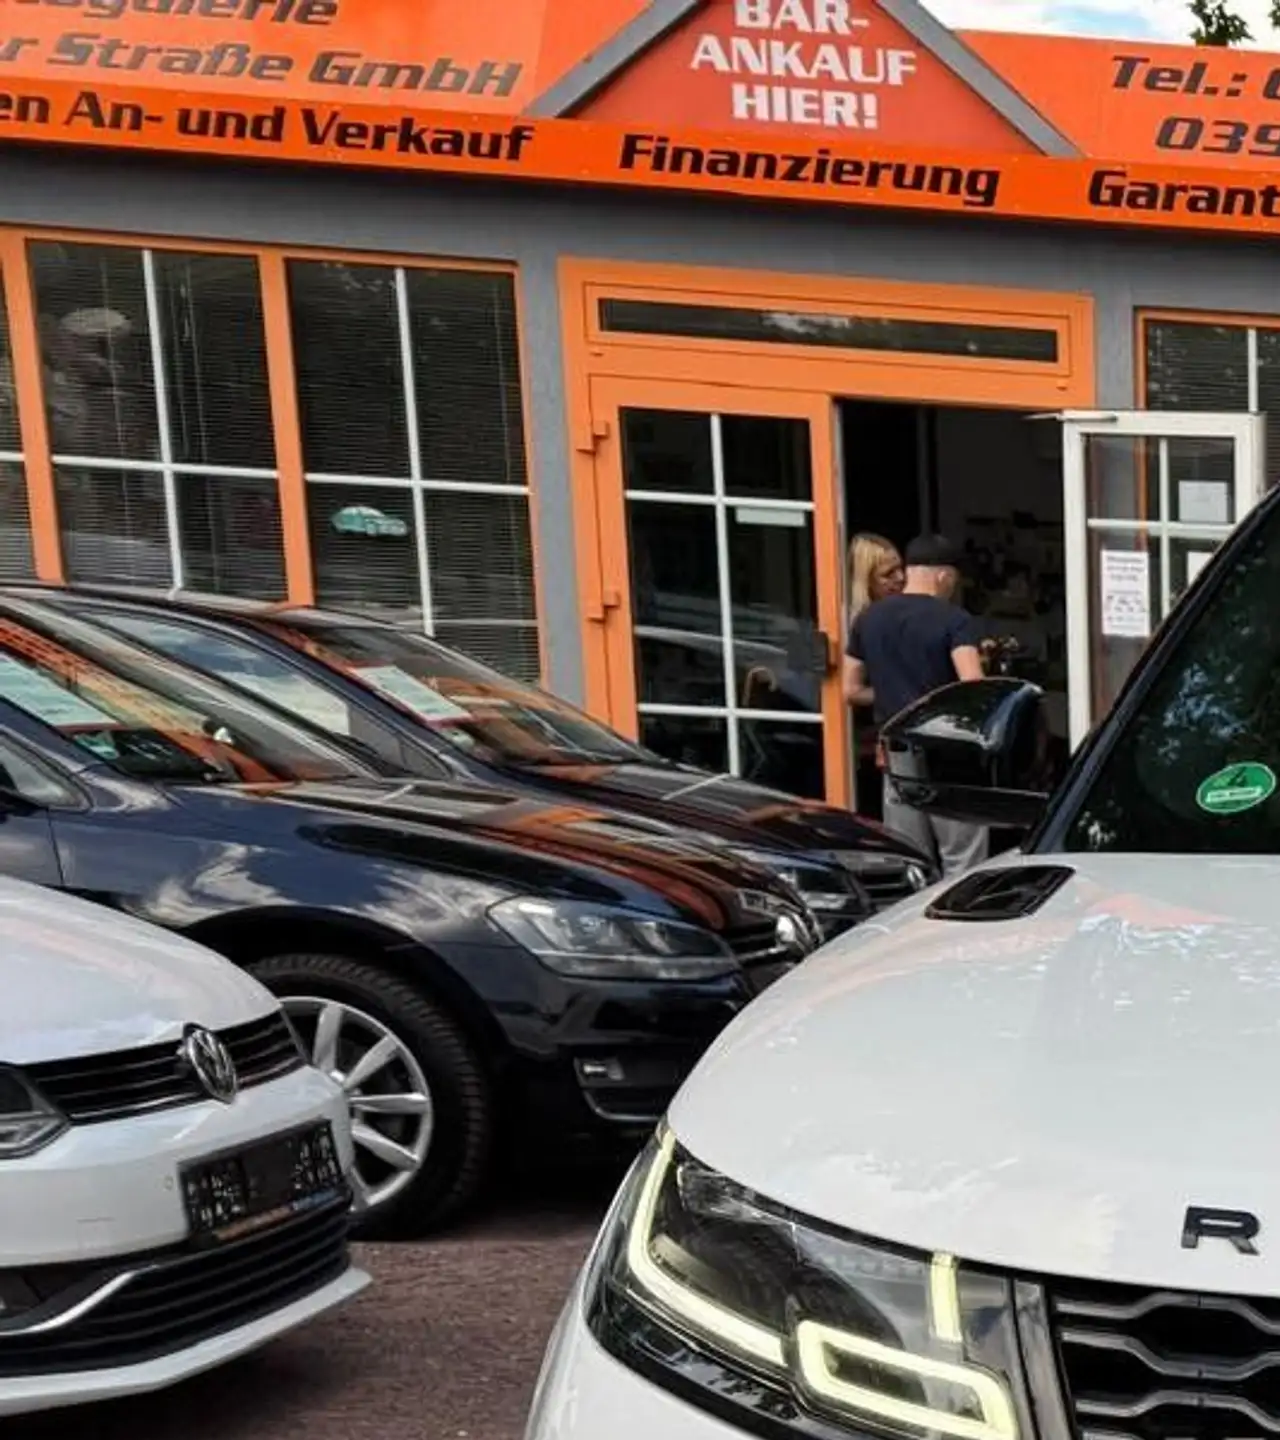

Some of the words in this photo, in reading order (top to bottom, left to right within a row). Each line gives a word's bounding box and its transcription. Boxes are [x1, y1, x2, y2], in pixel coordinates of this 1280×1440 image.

[735, 0, 871, 35] BAR-
[47, 32, 293, 81] Straße
[308, 50, 523, 97] GmbH
[690, 33, 917, 86] ANKAUF
[1112, 55, 1247, 97] Tel.:
[63, 90, 163, 131] An-
[177, 106, 286, 142] und
[301, 108, 535, 161] Verkauf
[731, 83, 879, 129] HIER!
[619, 133, 1000, 208] Finanzierung
